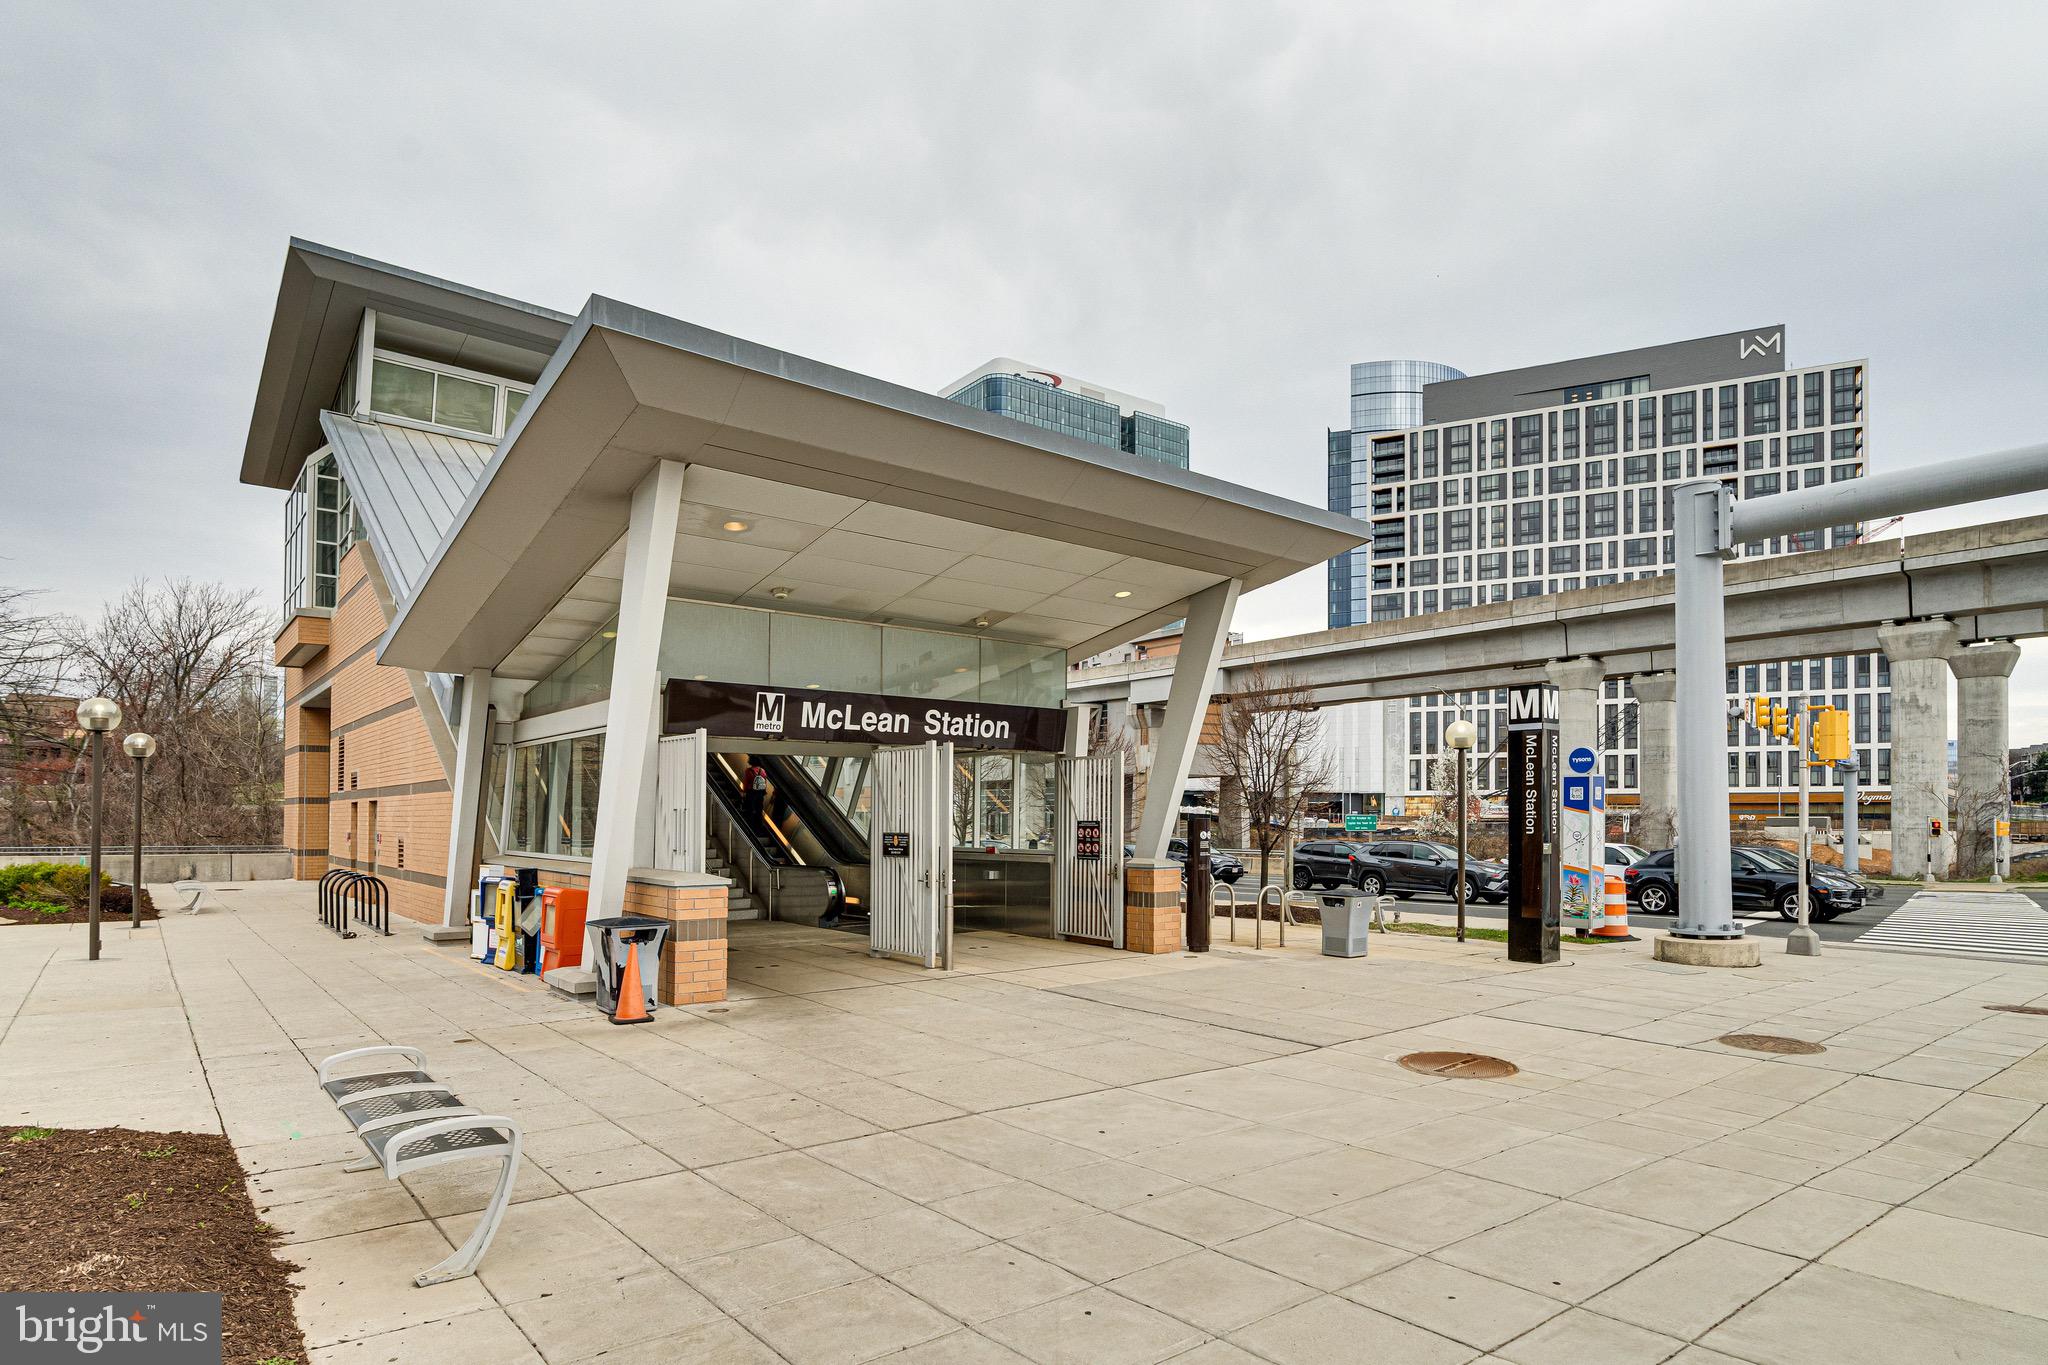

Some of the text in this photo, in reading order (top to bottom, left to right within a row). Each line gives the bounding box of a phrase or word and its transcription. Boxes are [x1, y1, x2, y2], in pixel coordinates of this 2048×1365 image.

[801, 701, 1010, 739] McLean Station
[1510, 688, 1540, 720] M
[1543, 688, 1559, 720] M
[756, 721, 782, 731] metro
[1525, 735, 1537, 835] McLean Station
